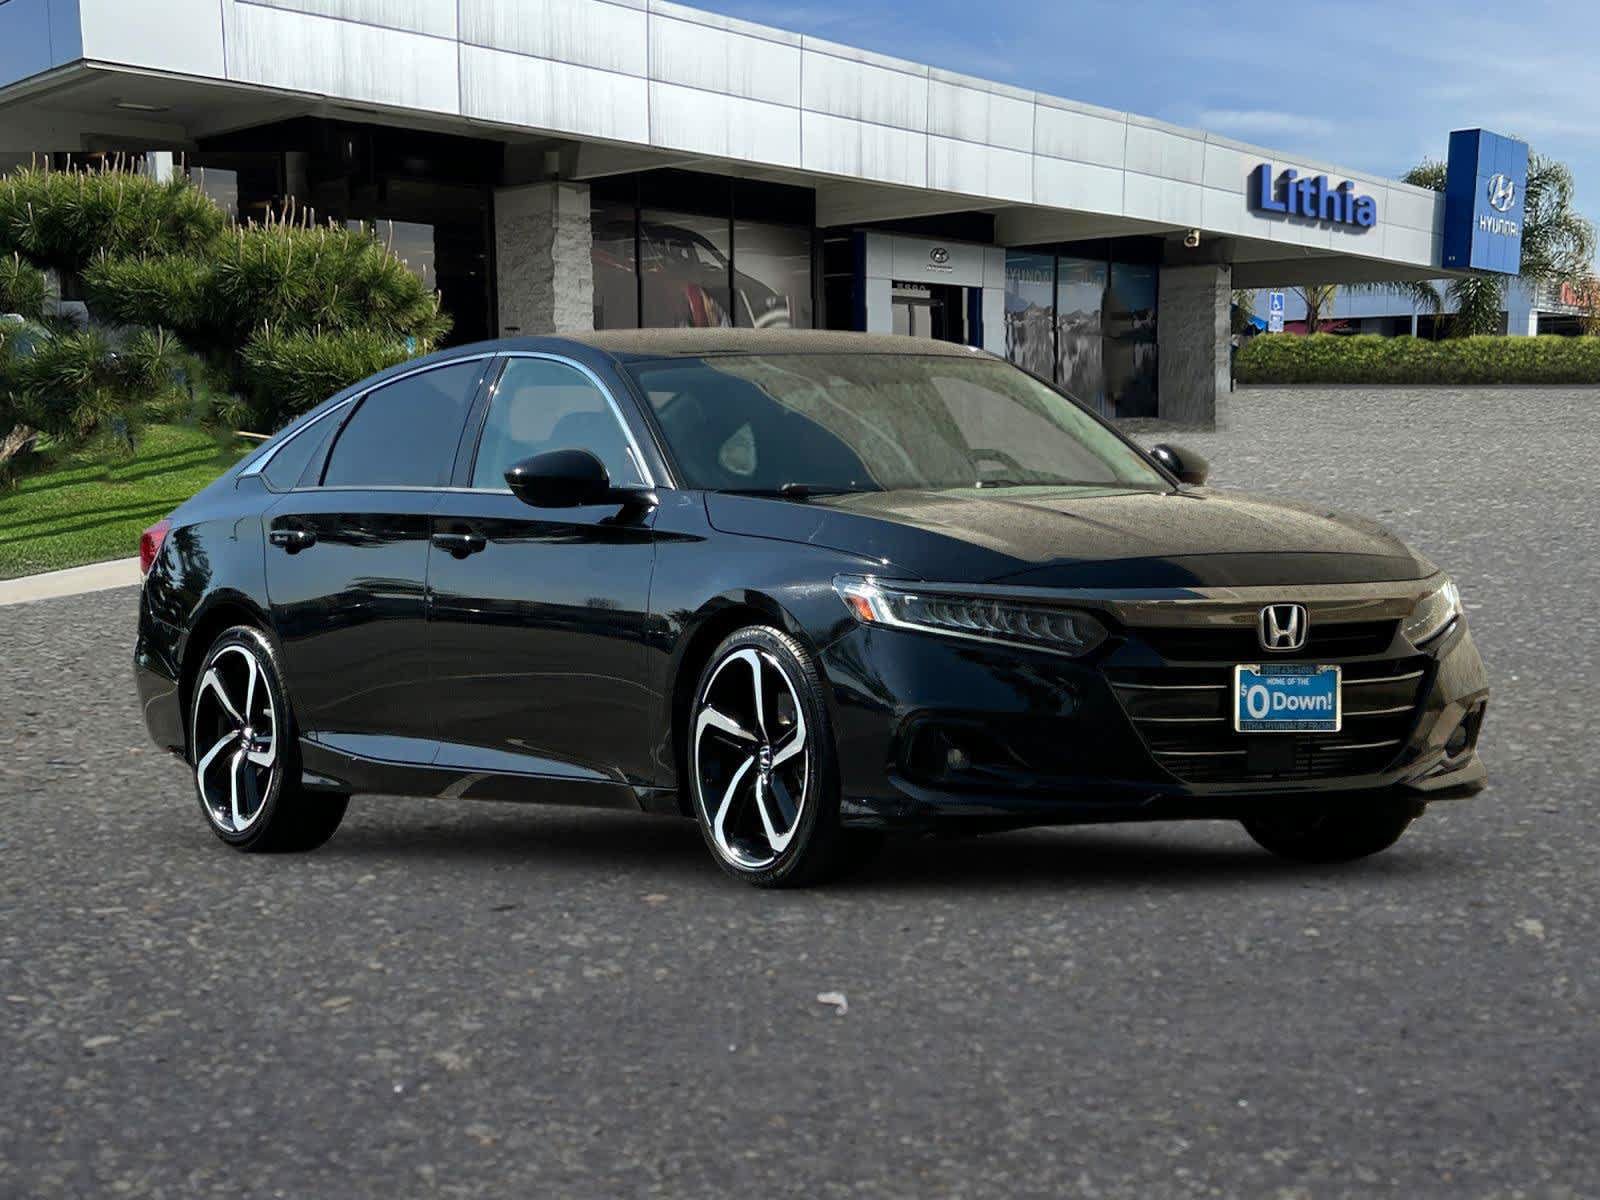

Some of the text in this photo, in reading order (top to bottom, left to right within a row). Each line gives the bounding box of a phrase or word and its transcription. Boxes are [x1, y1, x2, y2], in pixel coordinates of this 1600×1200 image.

[1260, 163, 1377, 227] Lithia
[1480, 215, 1520, 237] HYUNDAI
[1273, 692, 1332, 711] Down!
